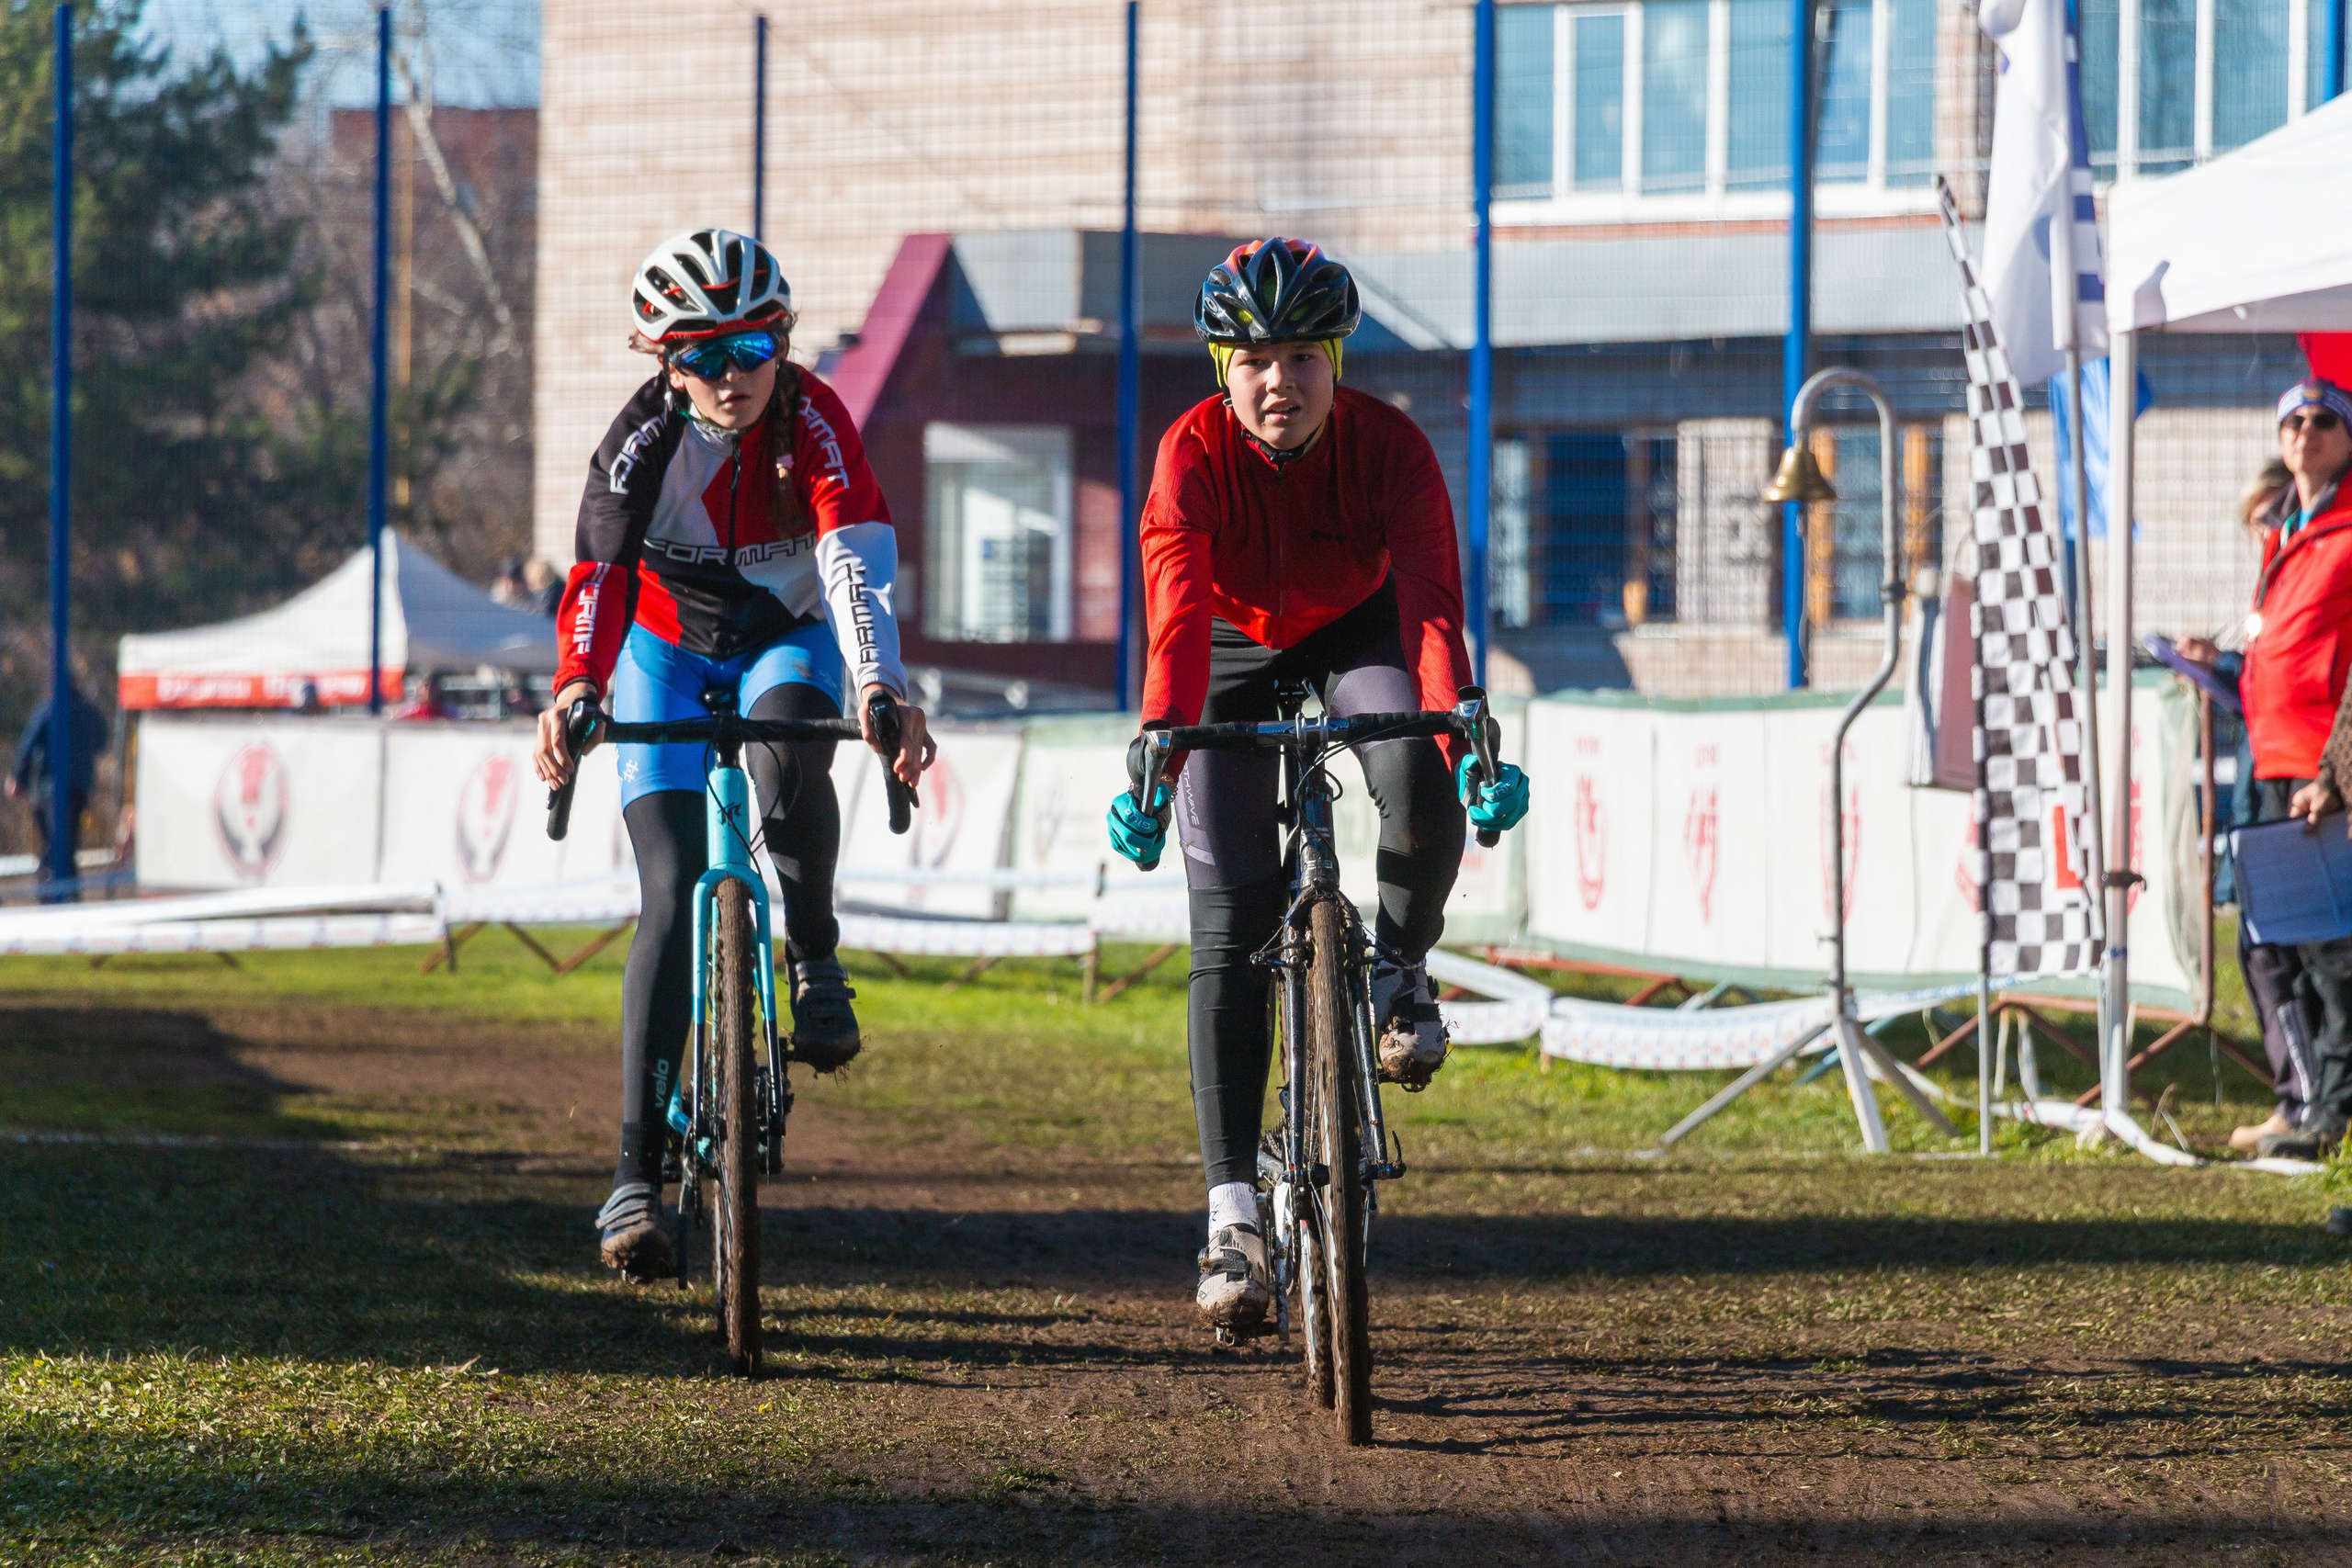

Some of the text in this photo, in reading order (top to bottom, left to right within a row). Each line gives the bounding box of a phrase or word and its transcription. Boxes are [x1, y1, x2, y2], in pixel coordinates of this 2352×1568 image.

[609, 413, 665, 495] FORM
[644, 529, 819, 568] FORMAT
[651, 1058, 670, 1108] velo
